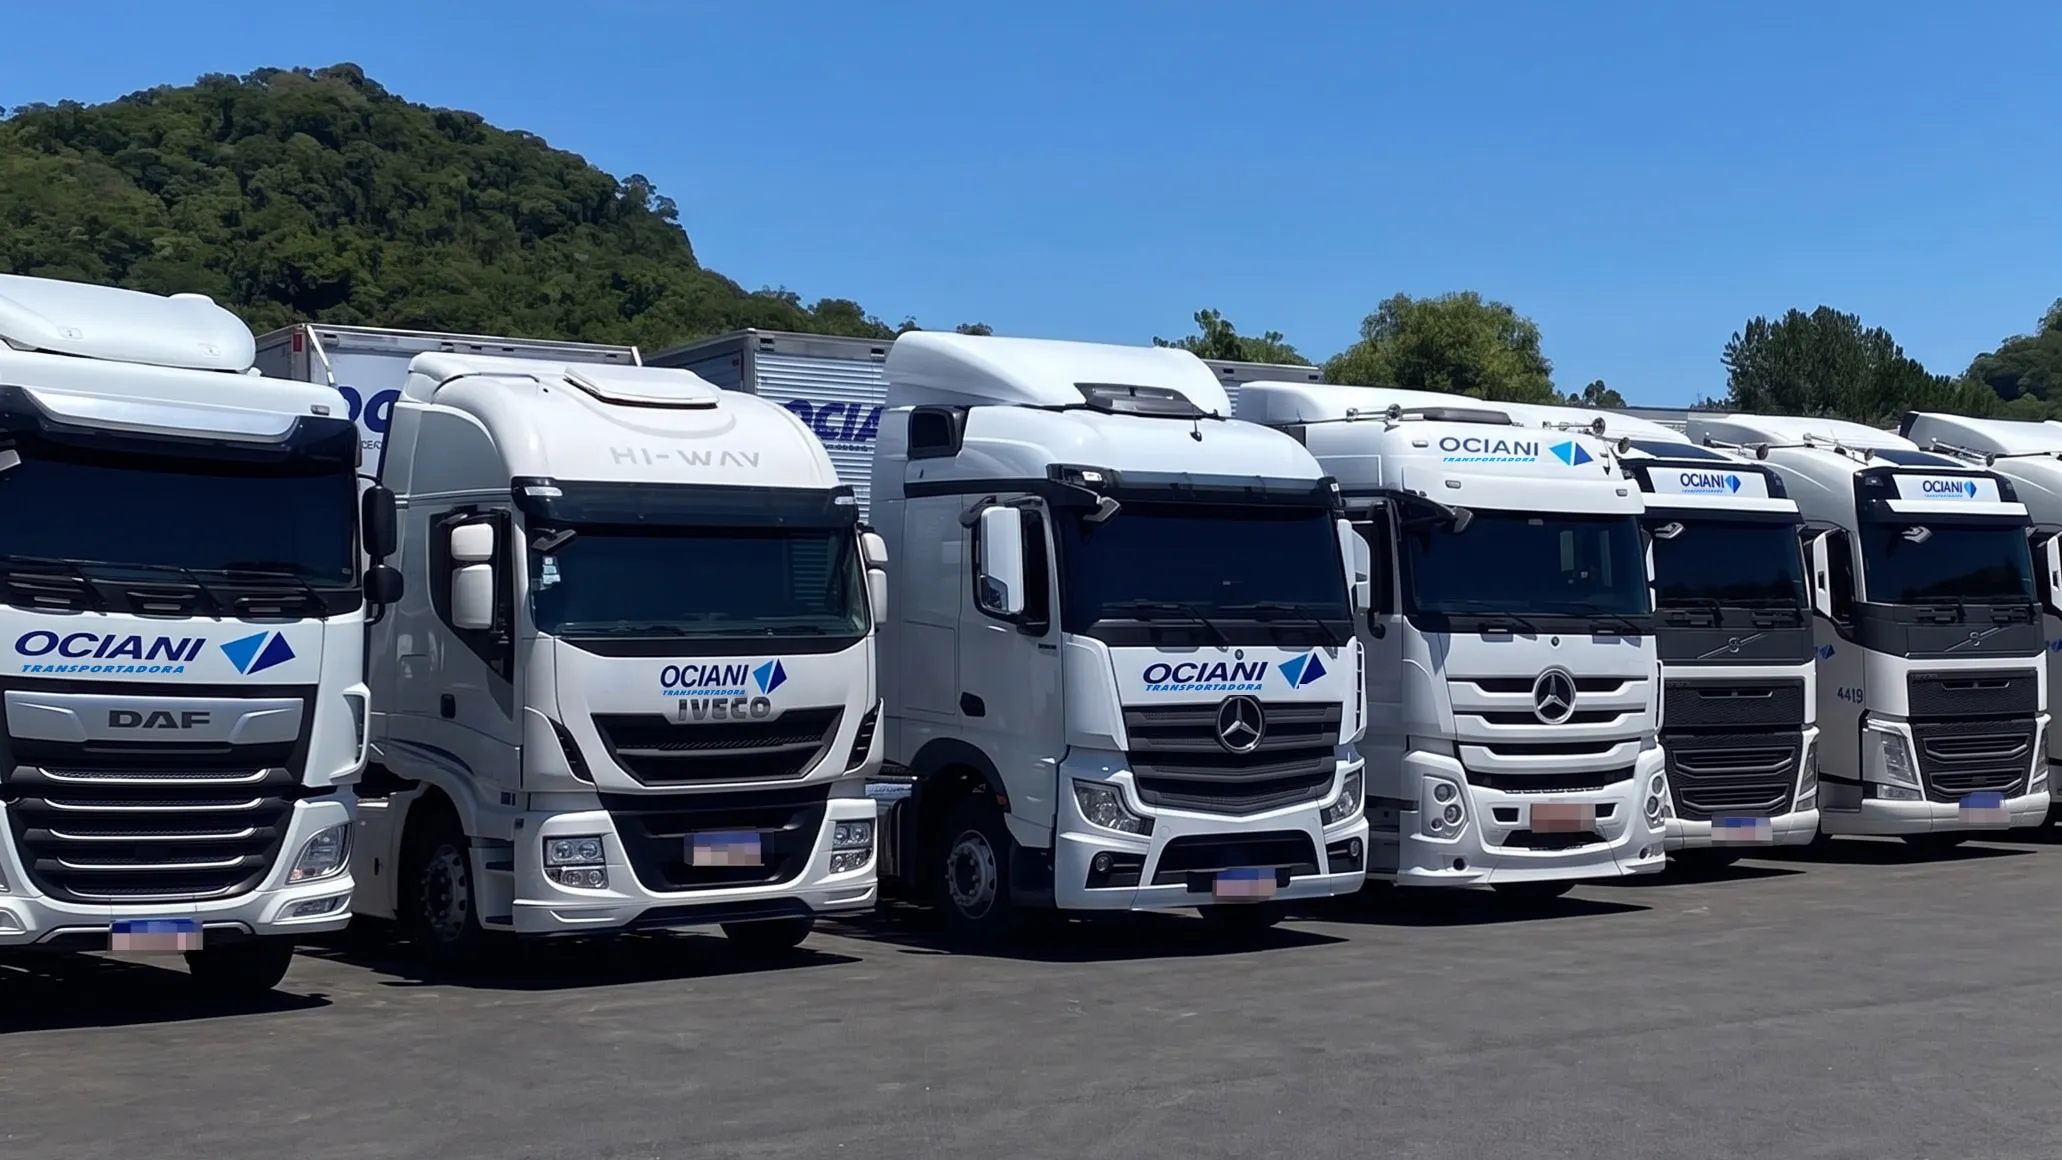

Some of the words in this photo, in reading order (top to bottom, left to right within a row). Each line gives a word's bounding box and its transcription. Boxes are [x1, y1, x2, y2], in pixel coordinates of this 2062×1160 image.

[1438, 436, 1539, 457] OCIANI
[1680, 473, 1725, 489] OCIANI
[1922, 480, 1963, 493] OCIANI
[14, 630, 207, 662] OCIANI
[21, 664, 185, 674] TRANSPORTADORA
[660, 664, 749, 688] OCIANI
[1142, 661, 1269, 684] OCIANI
[1145, 683, 1263, 692] TRANSPORTADORA
[1837, 686, 1864, 705] 4419
[677, 696, 771, 721] IVECO
[108, 709, 211, 729] DAF
